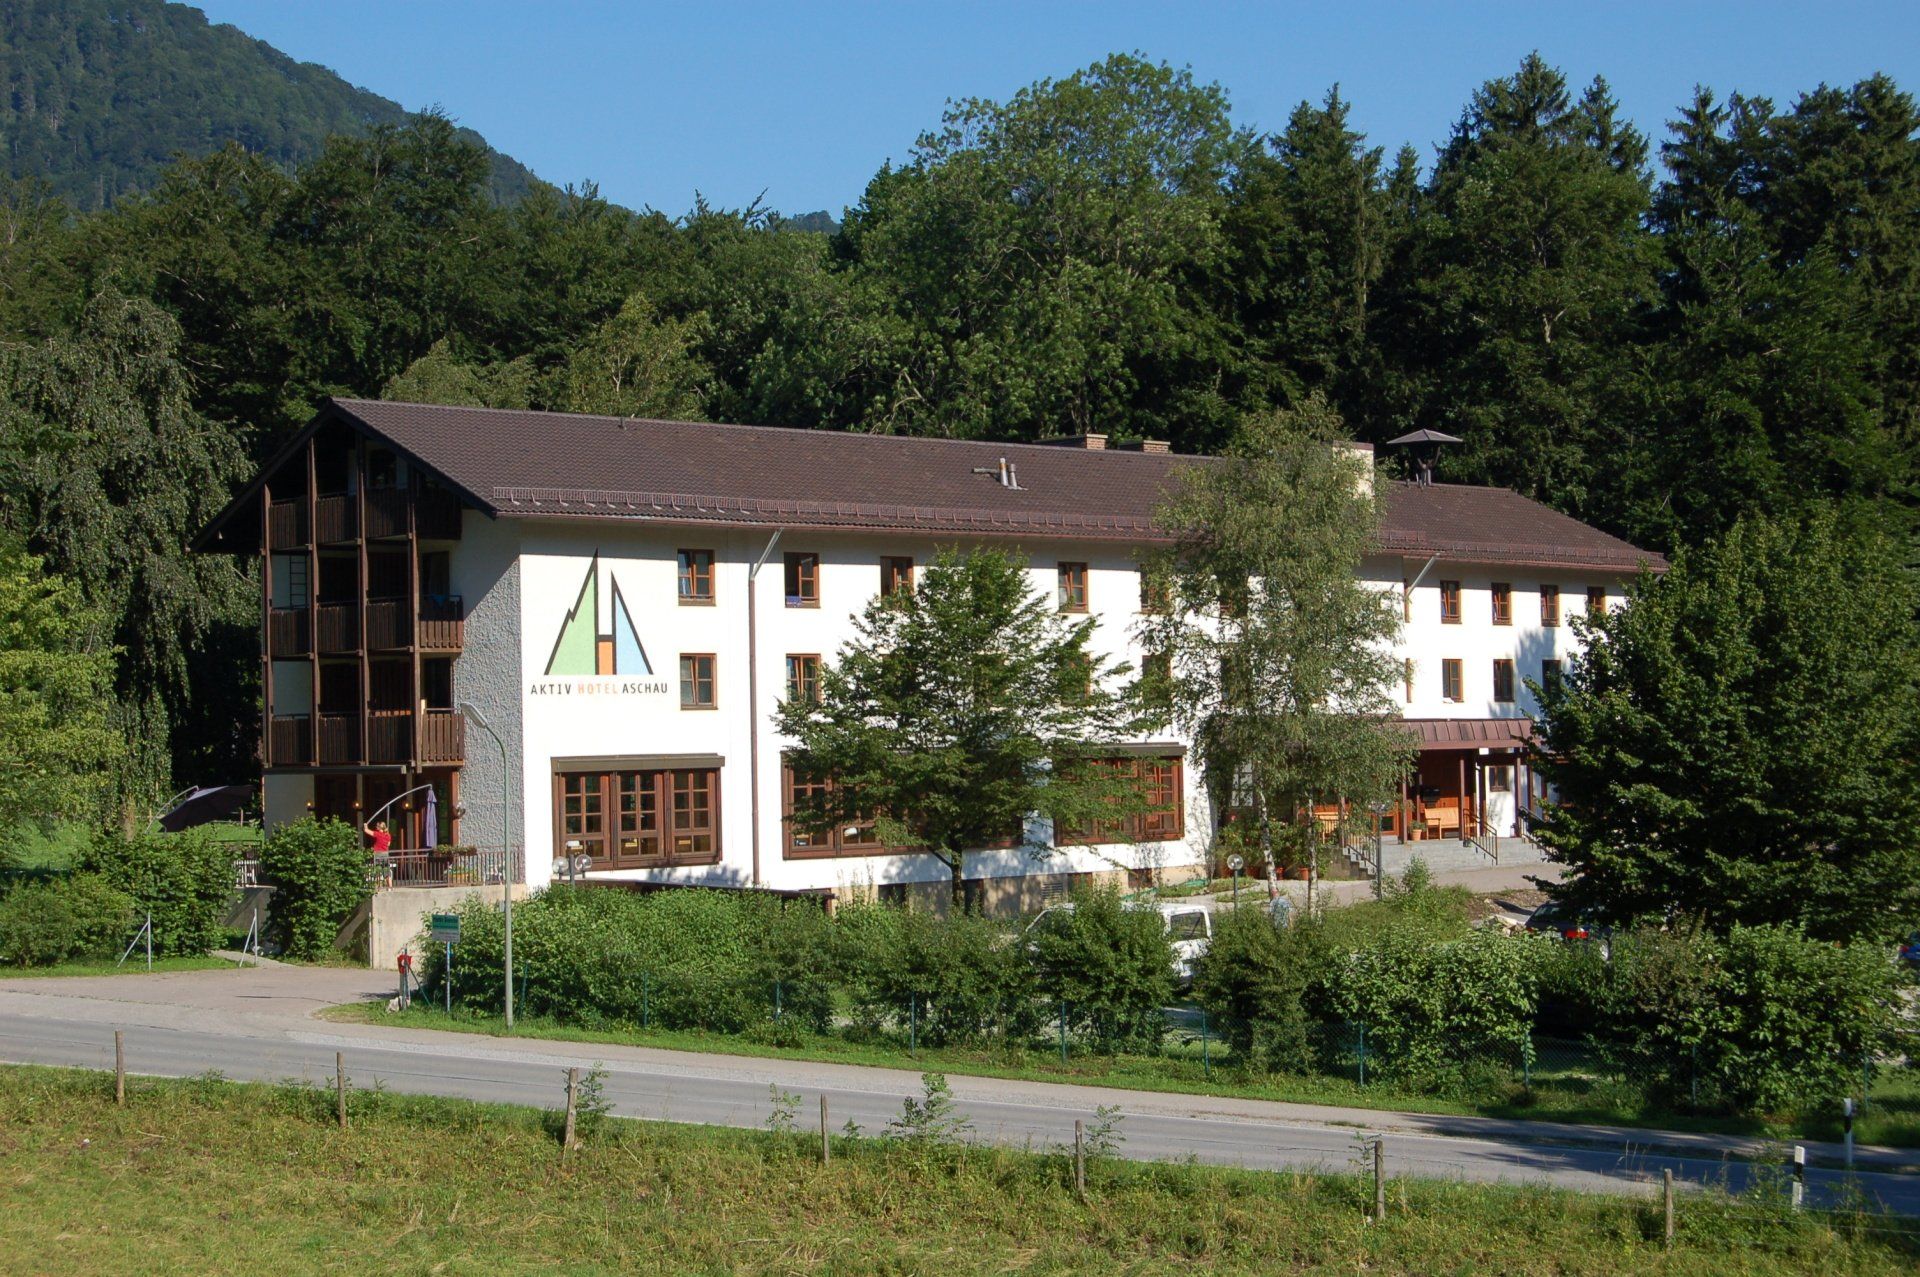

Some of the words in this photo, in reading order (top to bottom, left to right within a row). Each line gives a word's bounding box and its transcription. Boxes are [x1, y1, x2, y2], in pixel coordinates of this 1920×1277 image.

[530, 683, 571, 694] AKTIV
[577, 683, 618, 694] HOTEL
[622, 683, 668, 694] ASCHAU
